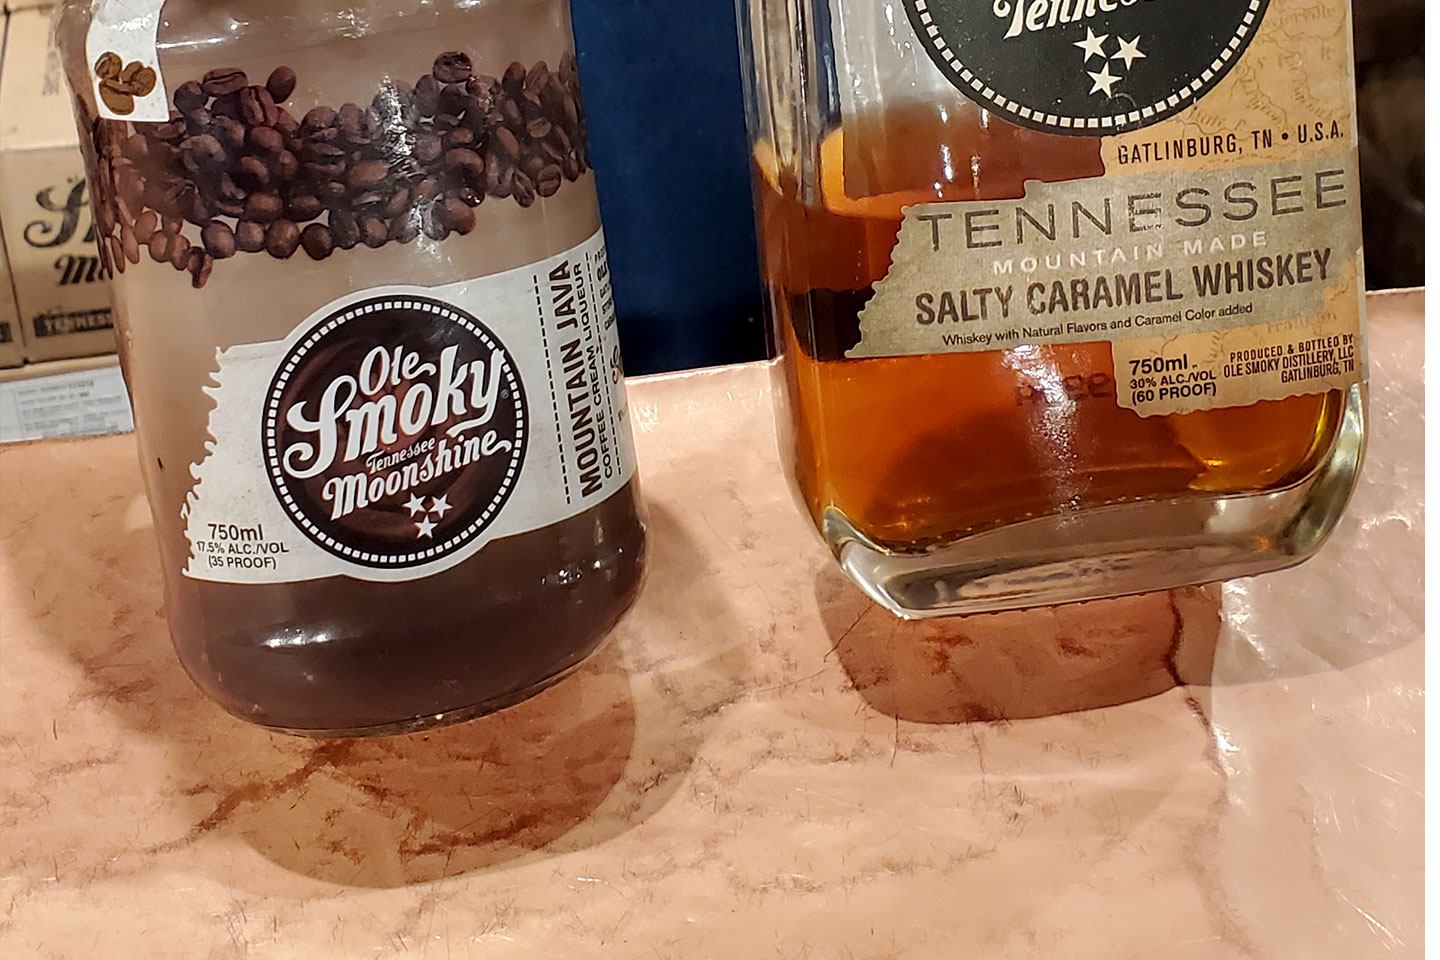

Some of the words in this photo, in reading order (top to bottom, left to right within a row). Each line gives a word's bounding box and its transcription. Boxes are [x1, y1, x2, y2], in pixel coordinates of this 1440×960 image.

[1118, 133, 1242, 165] GATLINBURG,
[1251, 129, 1272, 150] TN
[1297, 120, 1344, 144] U.S.A.
[917, 169, 1346, 252] TENNESSEE
[993, 244, 1163, 275] MOUNTAIN
[1184, 231, 1267, 256] MADE
[548, 260, 579, 330] JAVA
[573, 262, 593, 342] LIQUEUR
[915, 286, 1013, 325] SALTY
[1027, 269, 1183, 315] CARAMEL
[1192, 248, 1331, 297] WHISKEY
[942, 331, 992, 346] Whiskey
[995, 329, 1020, 341] with
[1022, 323, 1064, 338] Natural
[1067, 320, 1107, 334] Flavors
[1110, 316, 1132, 328] and
[1134, 311, 1182, 326] Caramel
[1185, 308, 1216, 321] Color
[1218, 302, 1253, 317] added
[359, 344, 436, 395] Ole
[1129, 354, 1187, 375] 750ml
[1223, 363, 1243, 378] OLE
[1245, 358, 1280, 375] SMOKY
[1282, 349, 1337, 369] DISTILLERY,
[1338, 345, 1354, 360] LLC
[1230, 345, 1283, 363] PRODUCED
[1287, 344, 1295, 355] &
[1298, 336, 1339, 352] BOTTLED
[1342, 333, 1354, 345] BY
[586, 345, 602, 406] CREAM
[1130, 377, 1157, 389] 30%
[1160, 370, 1217, 386] ALC./VOL
[1281, 362, 1341, 383] GATLINBURG,
[1343, 358, 1355, 373] TN
[283, 344, 505, 478] Smoky
[1132, 389, 1155, 406] (60
[1159, 382, 1217, 400] PROOF)
[559, 338, 603, 498] MOUNTAIN
[366, 437, 436, 474] Tennessee
[595, 408, 614, 479] COFFEE
[322, 430, 512, 521] Moonshine
[196, 541, 225, 554] 17.5%
[228, 542, 290, 555] ALC./VOL
[207, 523, 264, 541] 750ml
[208, 555, 224, 568] (35
[227, 556, 277, 570] PROOF)
